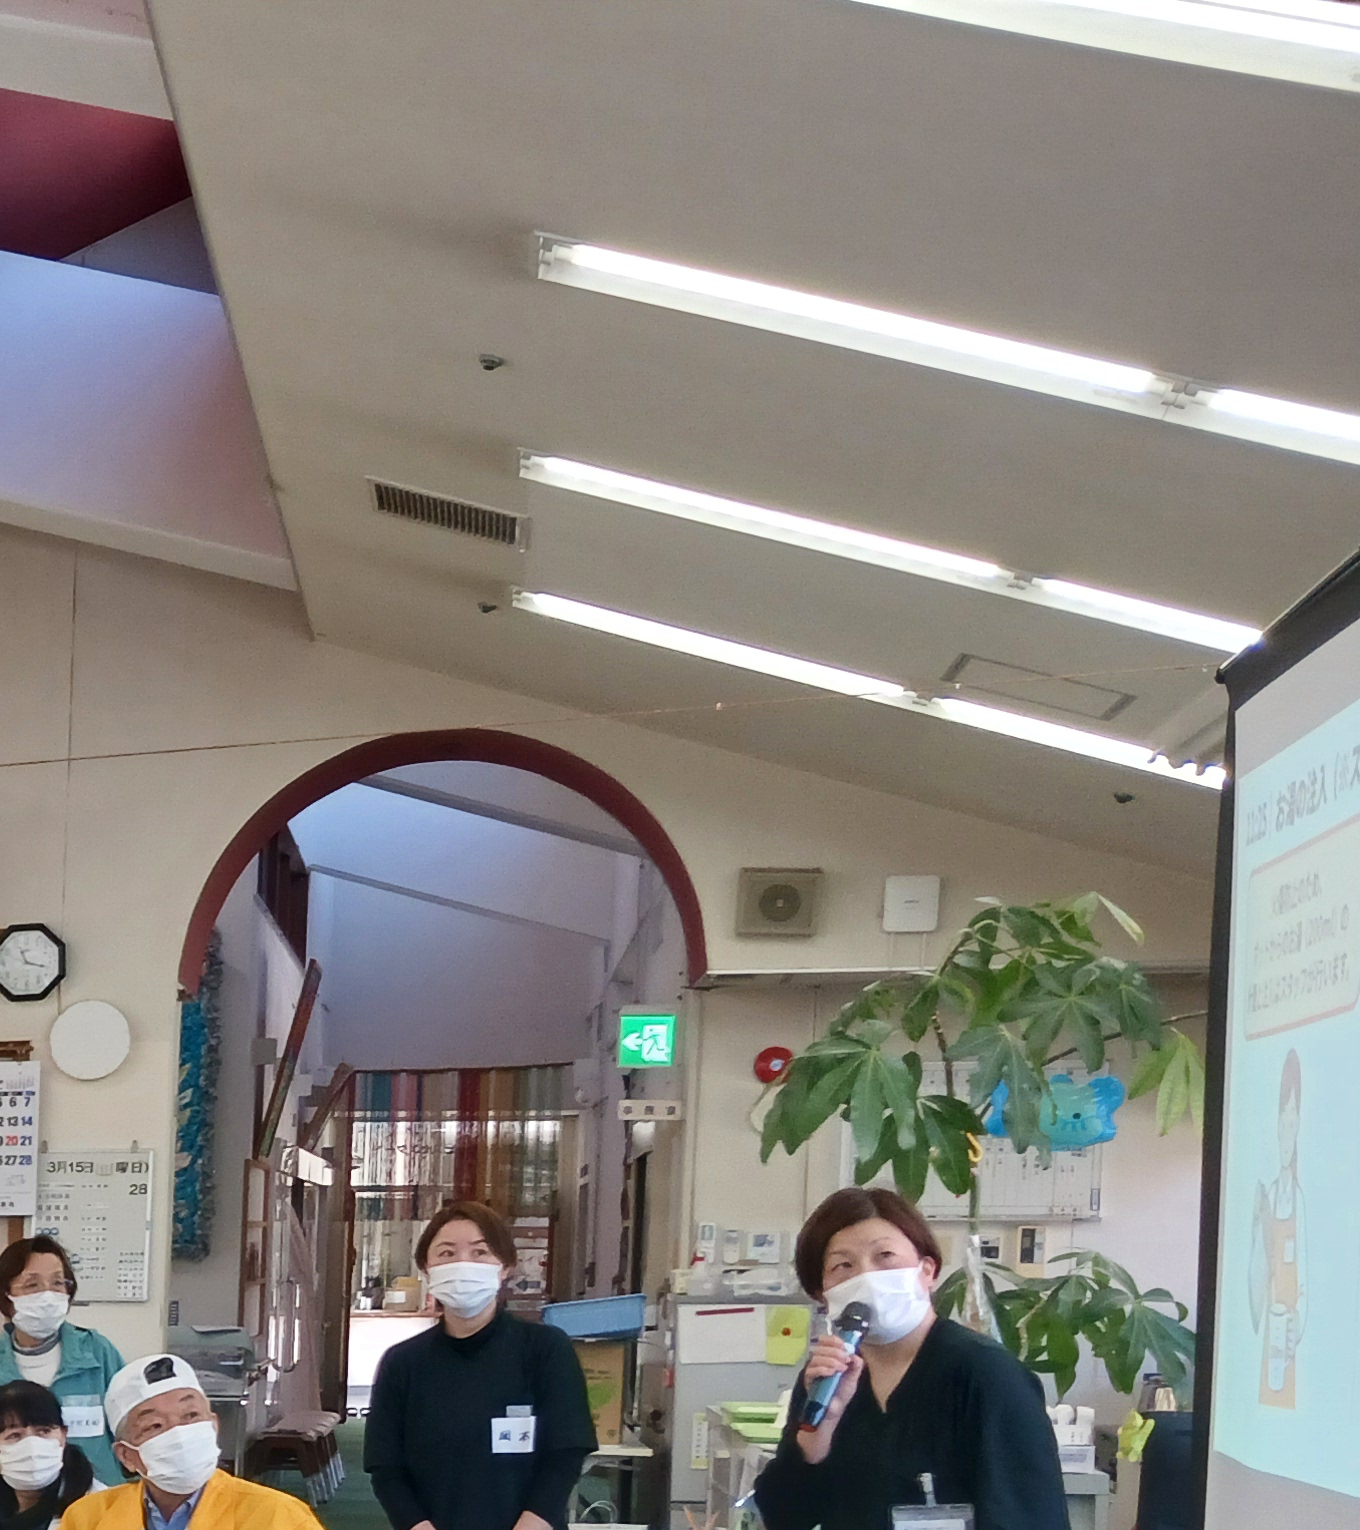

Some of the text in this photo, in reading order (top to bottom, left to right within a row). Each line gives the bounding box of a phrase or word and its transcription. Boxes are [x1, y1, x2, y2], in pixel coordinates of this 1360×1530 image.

[9, 1097, 17, 1107] 6
[24, 1097, 30, 1107] 7
[7, 1116, 18, 1126] 13
[21, 1116, 32, 1126] 14
[5, 1136, 18, 1146] 20
[20, 1136, 32, 1146] 21
[4, 1155, 17, 1165] 27
[18, 1155, 32, 1165] 28
